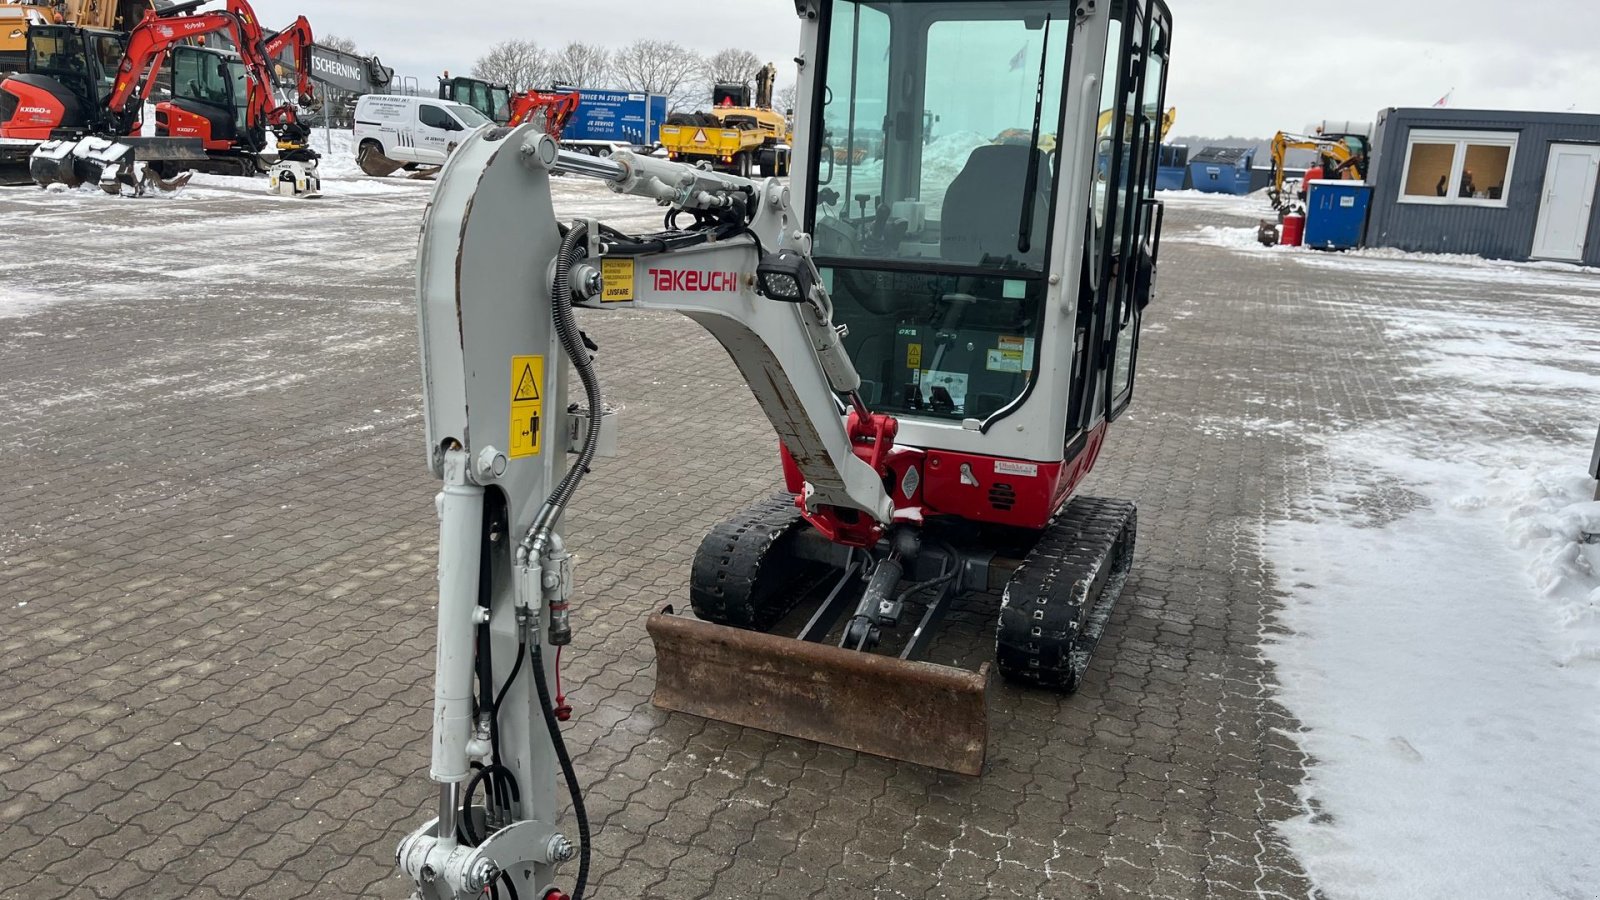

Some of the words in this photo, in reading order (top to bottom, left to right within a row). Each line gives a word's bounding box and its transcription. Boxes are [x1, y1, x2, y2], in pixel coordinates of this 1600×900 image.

[311, 55, 361, 81] TSCHERNING
[606, 288, 630, 296] LIVSFARE
[648, 268, 737, 292] TAKEUCHI
